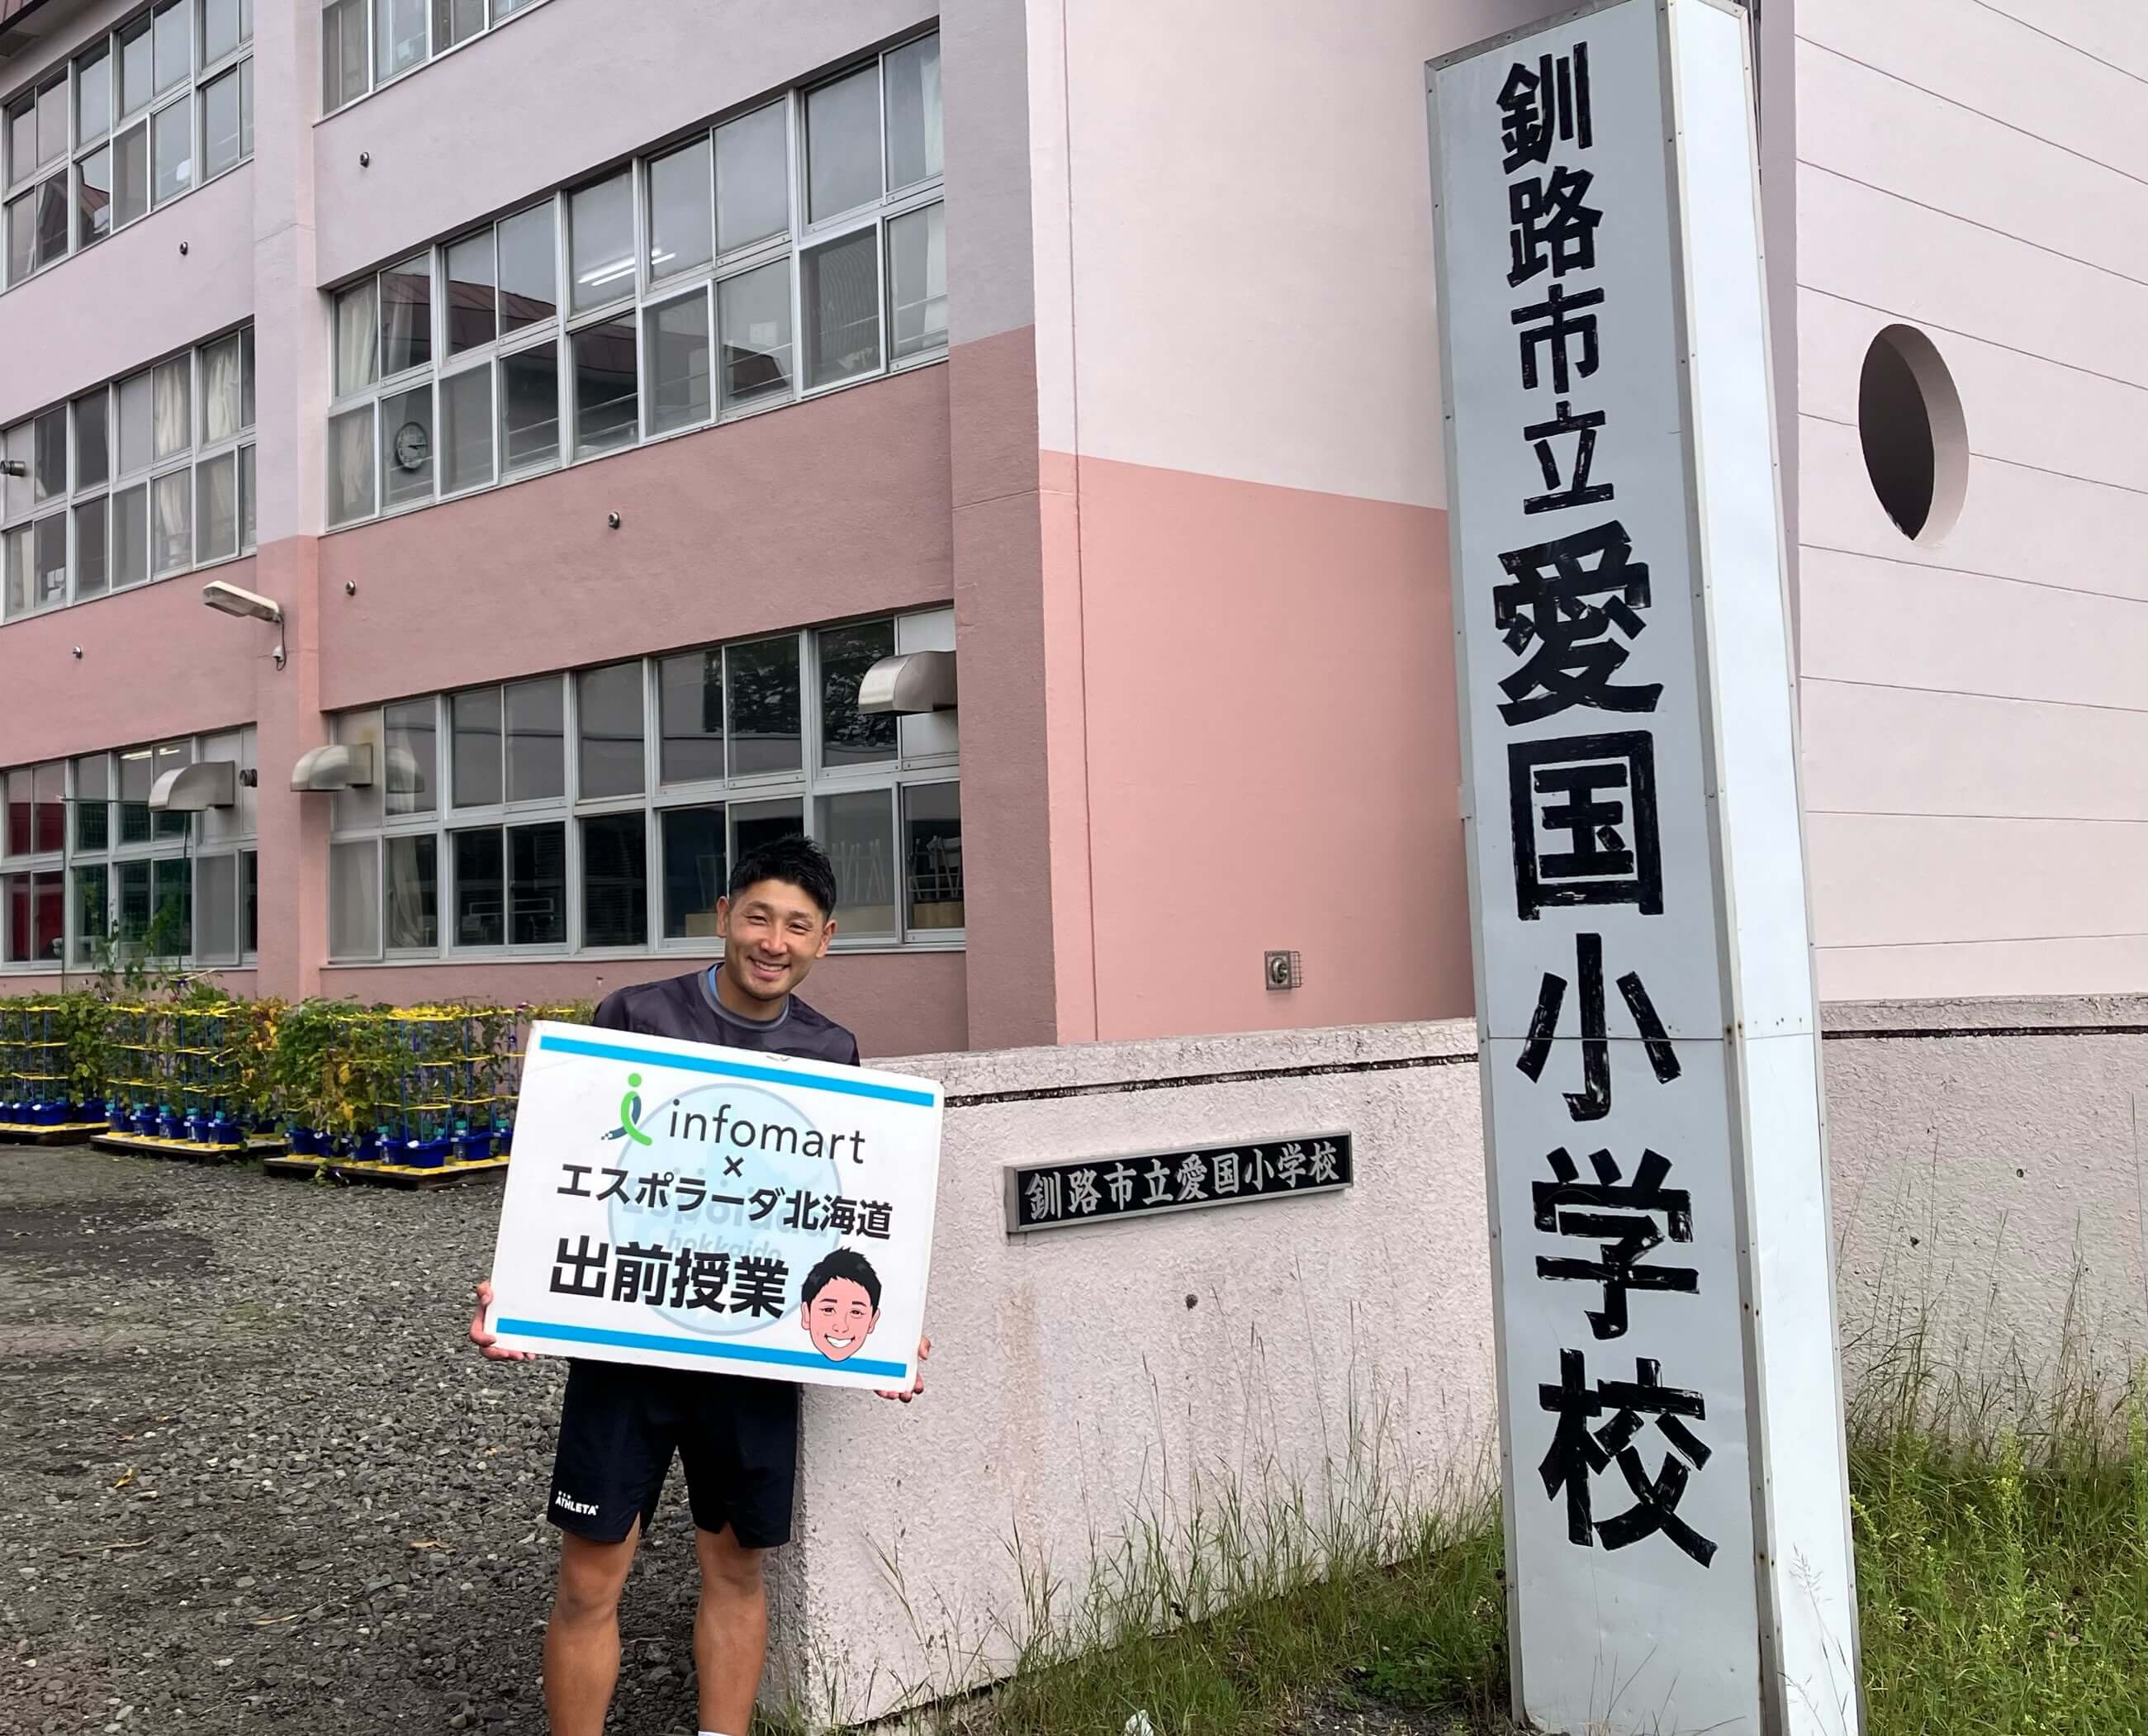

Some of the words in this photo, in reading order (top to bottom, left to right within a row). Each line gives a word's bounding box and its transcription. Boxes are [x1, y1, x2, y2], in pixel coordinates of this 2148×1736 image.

[1493, 41, 1719, 1568] 釧路市立愛国小学校
[669, 1098, 866, 1165] infomart
[557, 1163, 894, 1240] エスポラーダ北海道
[1024, 1140, 1340, 1221] 釧路市立愛国小学校
[548, 1235, 789, 1320] 出前授業
[555, 1496, 597, 1516] ATHLETA
